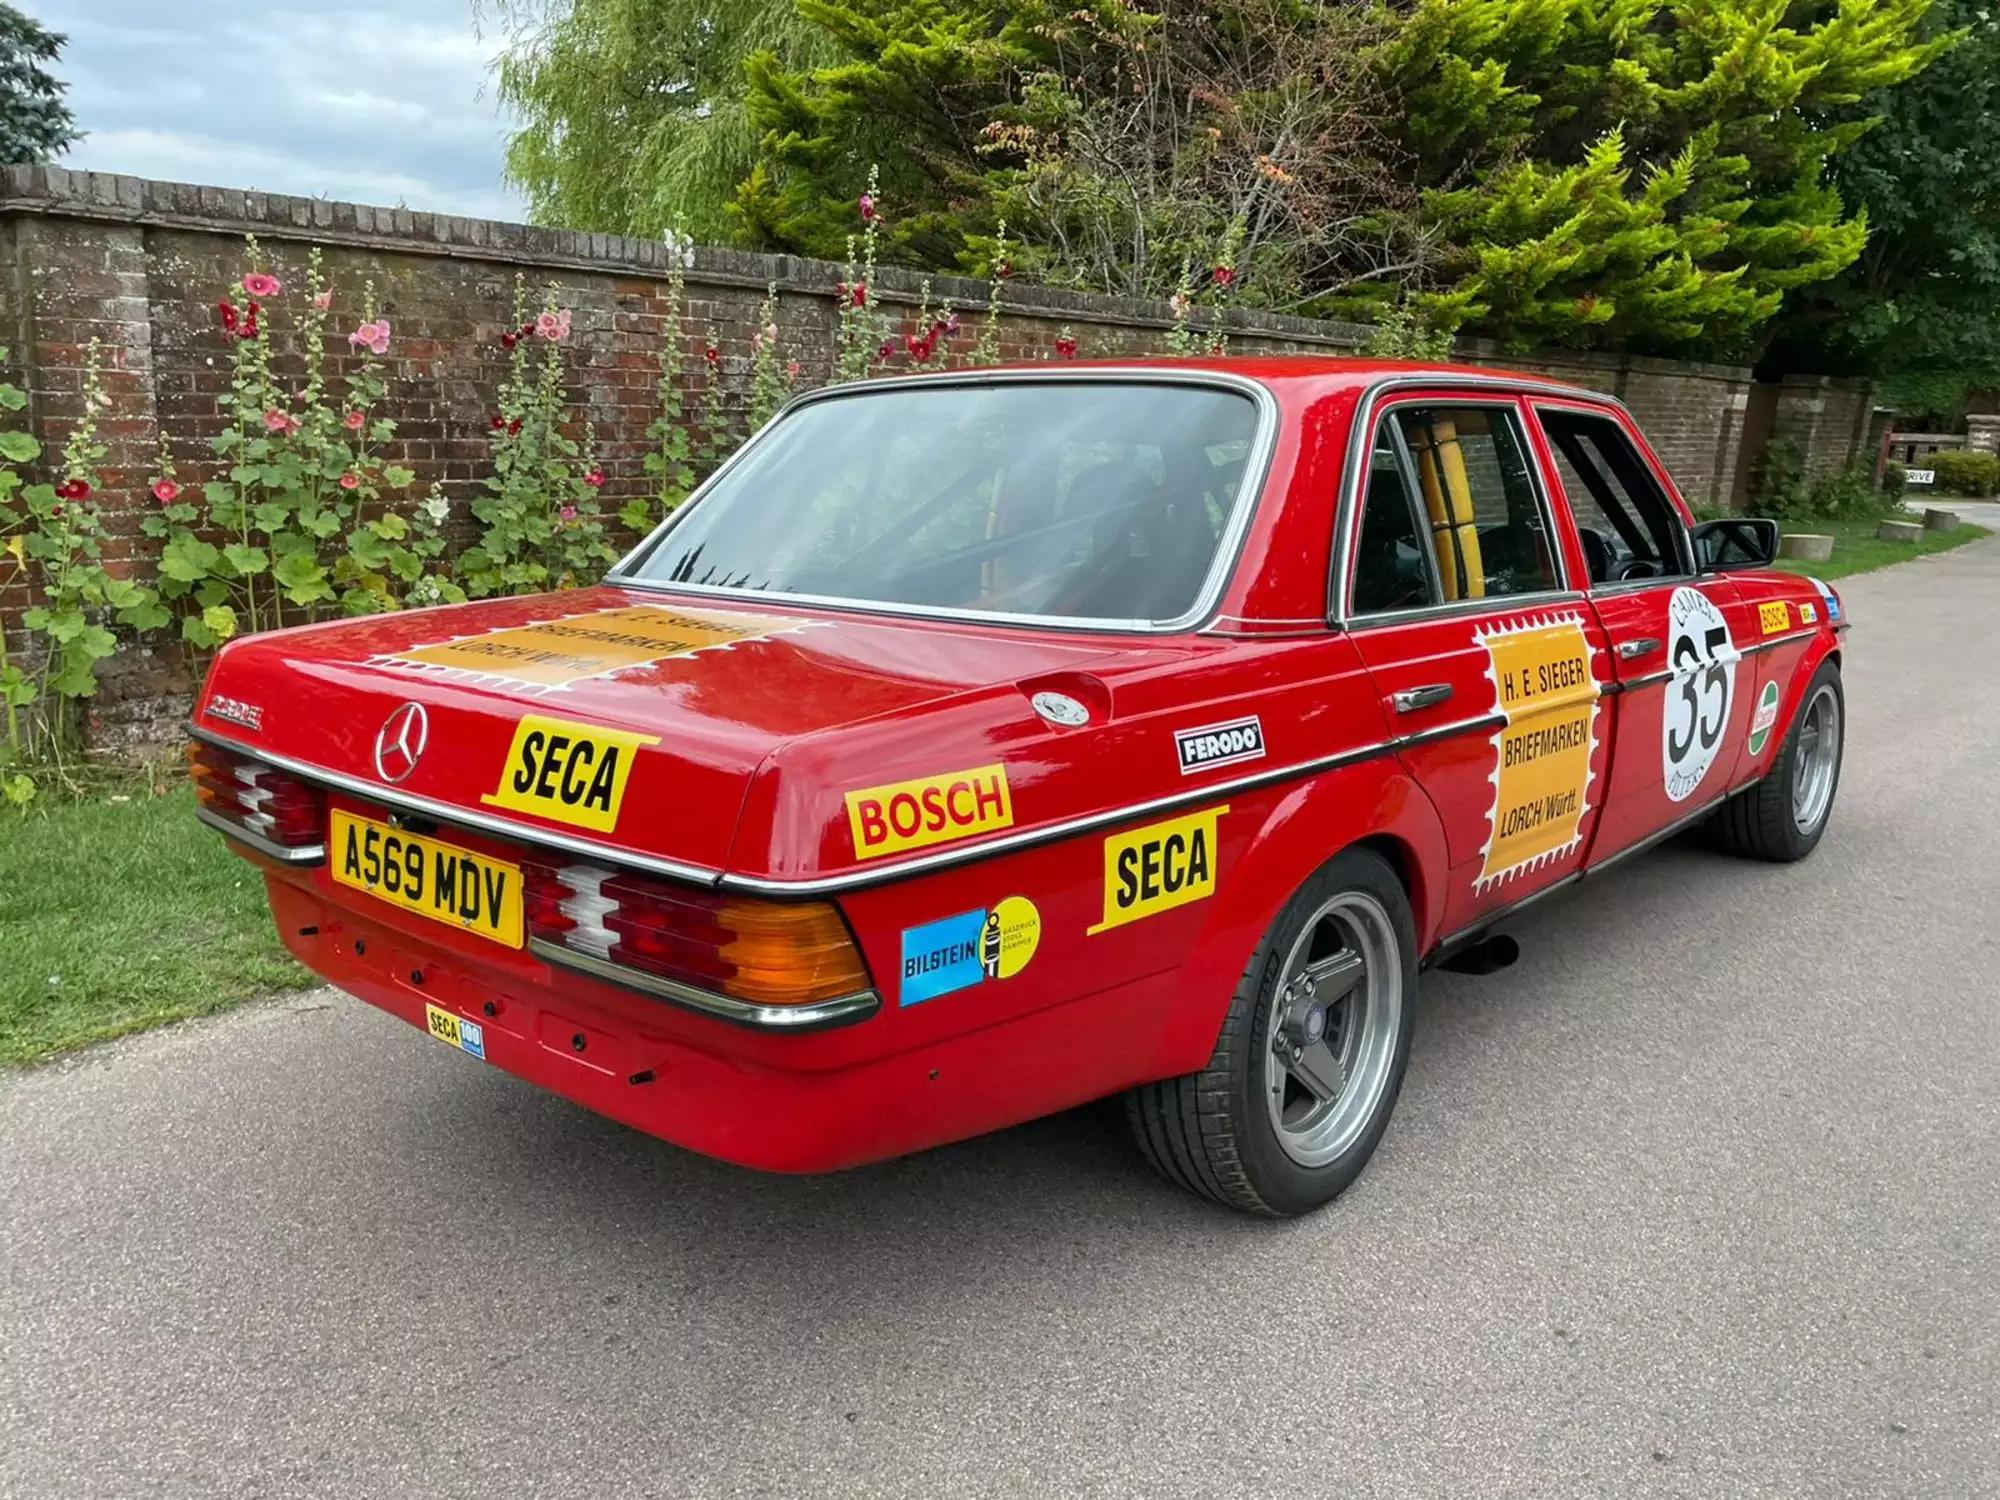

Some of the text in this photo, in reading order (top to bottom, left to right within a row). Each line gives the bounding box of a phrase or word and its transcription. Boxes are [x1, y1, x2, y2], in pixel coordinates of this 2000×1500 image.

[1761, 607, 1785, 628] BOSCH
[1504, 658, 1584, 702] H. E. SIEGER
[1668, 627, 1727, 764] 35
[1183, 727, 1256, 763] FERODO
[1505, 718, 1588, 768] BRIEFMARKEN
[513, 730, 620, 813] SECA
[858, 775, 1004, 847] BOSCH
[344, 822, 506, 929] A569 MDV
[1116, 827, 1209, 909] SECA
[904, 939, 976, 979] BILSTEIN
[430, 1011, 480, 1046] SECA 100
